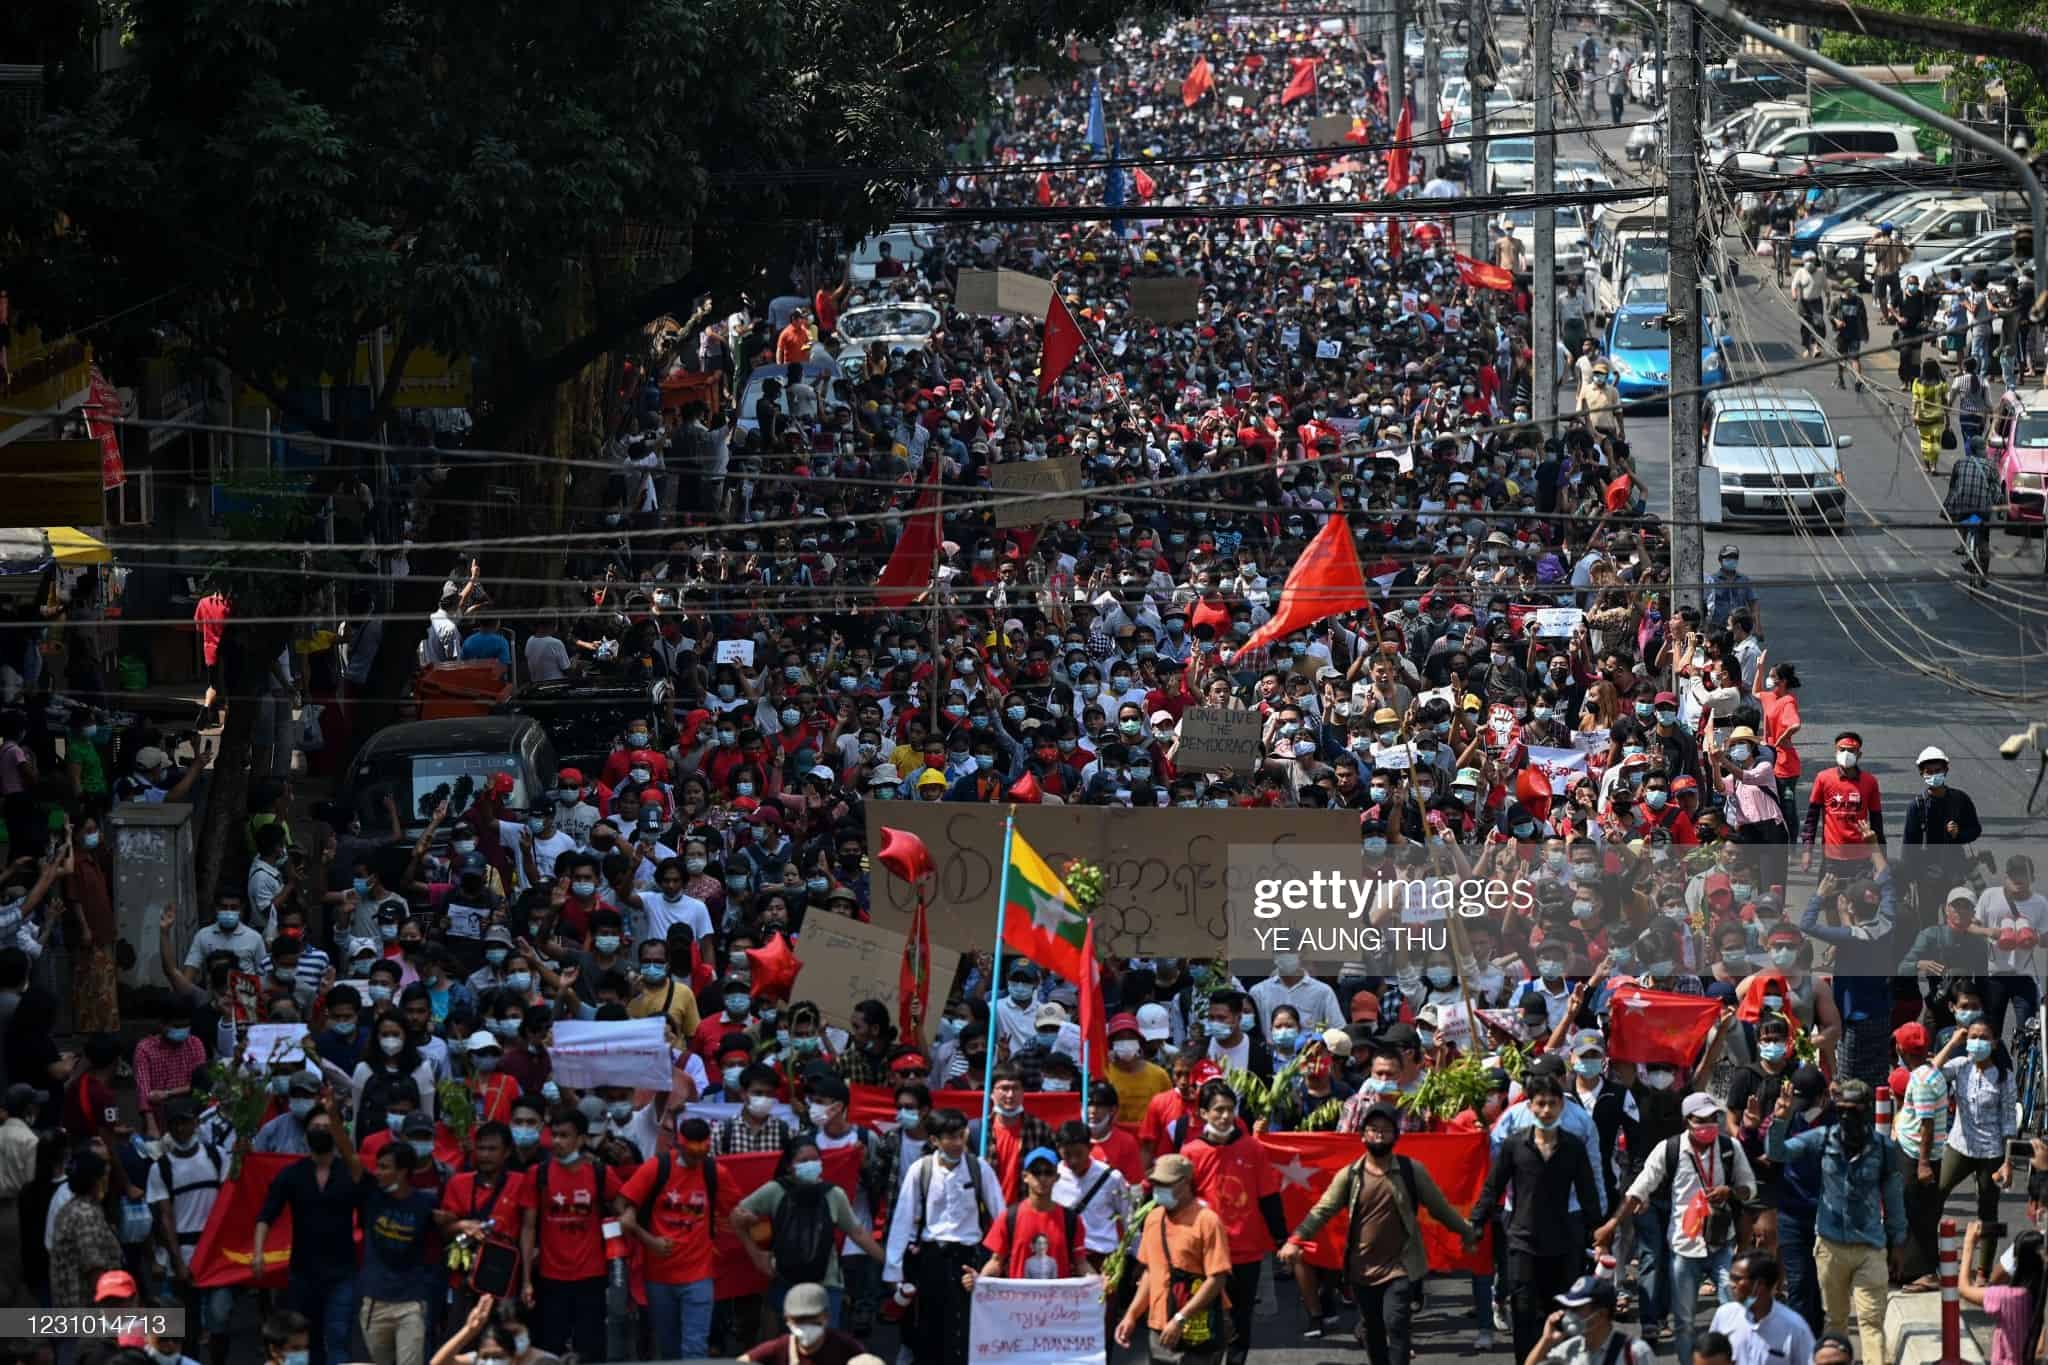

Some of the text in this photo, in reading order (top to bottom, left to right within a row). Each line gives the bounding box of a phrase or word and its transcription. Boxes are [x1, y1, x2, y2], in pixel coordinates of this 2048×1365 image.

[1190, 708, 1257, 724] LONG LIVE
[1210, 721, 1233, 736] THE
[1182, 735, 1261, 756] DEMOCRACY
[976, 1335, 1096, 1355] #SAVE MYANMAR
